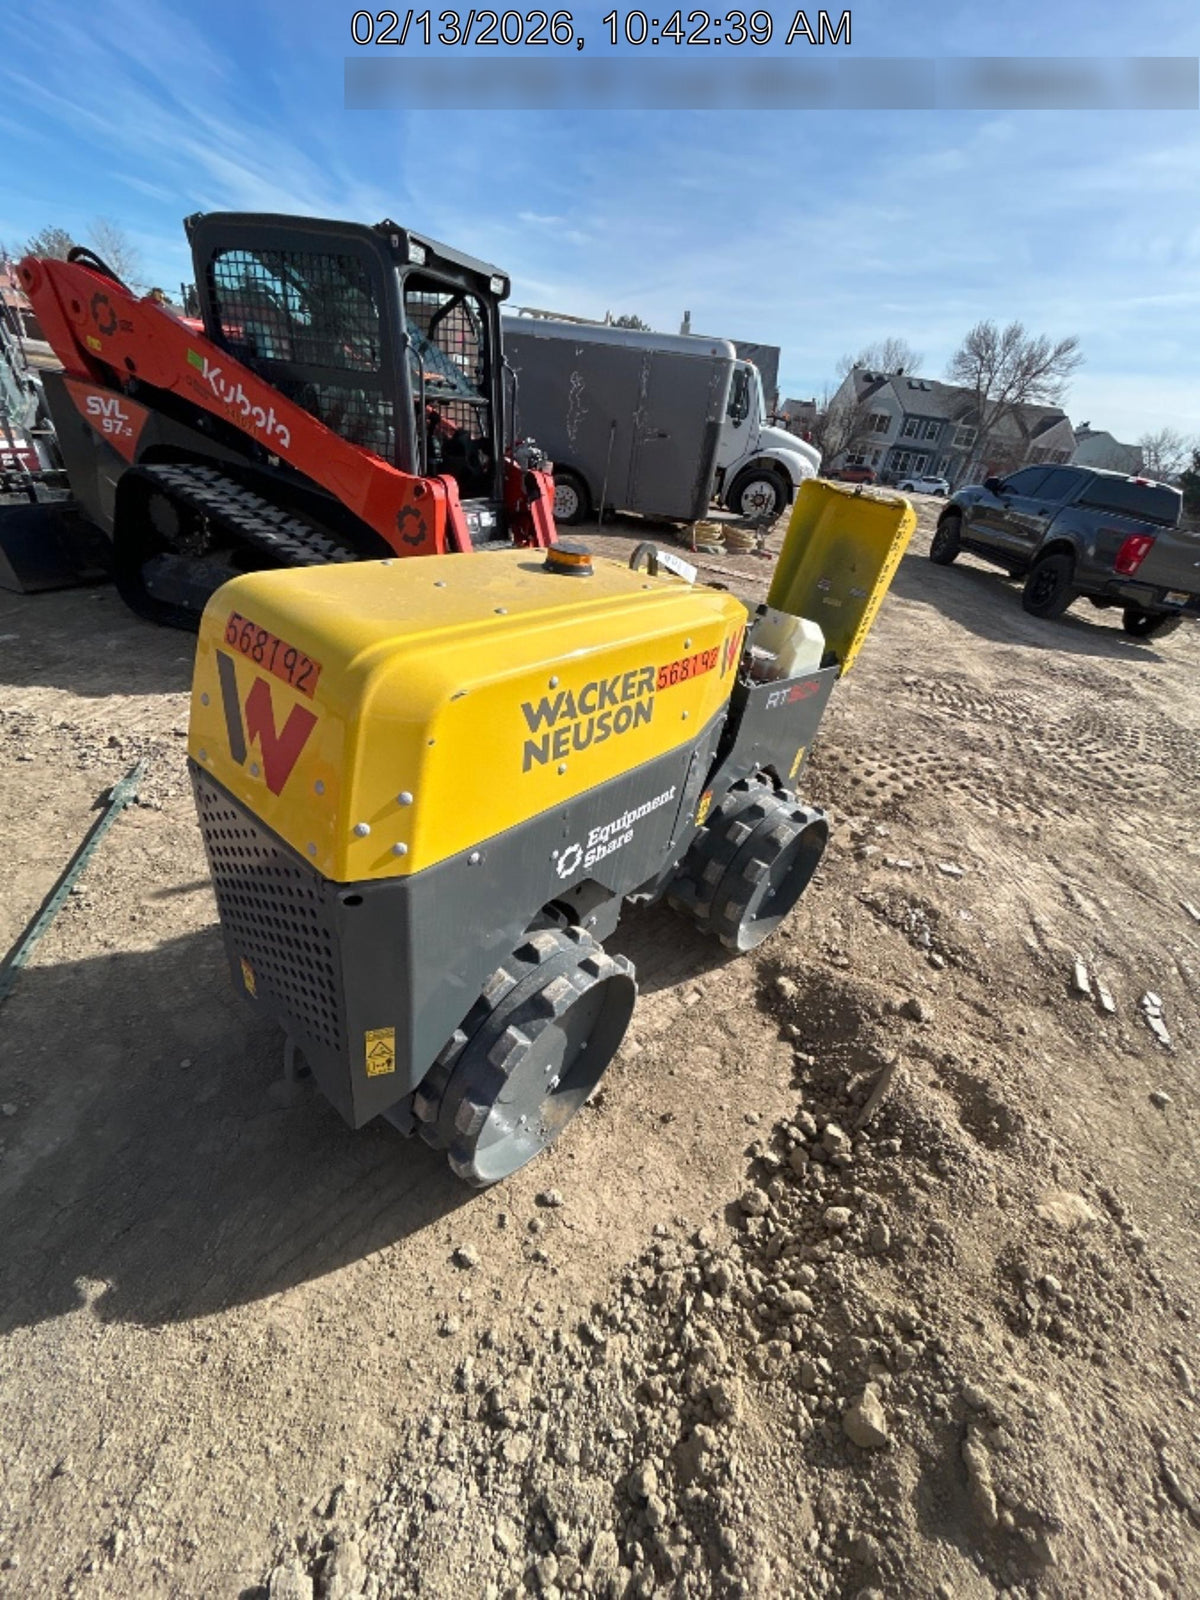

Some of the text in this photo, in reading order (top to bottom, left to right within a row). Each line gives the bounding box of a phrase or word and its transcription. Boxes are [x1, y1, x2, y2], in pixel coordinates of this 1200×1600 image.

[86, 395, 129, 420] SVL
[202, 357, 291, 448] Kubota
[226, 613, 315, 692] 568192
[658, 646, 720, 690] 568192
[520, 665, 656, 734] WACKER
[521, 696, 655, 774] NEUSON
[583, 829, 634, 868] Share
[586, 785, 677, 848] Equipment
